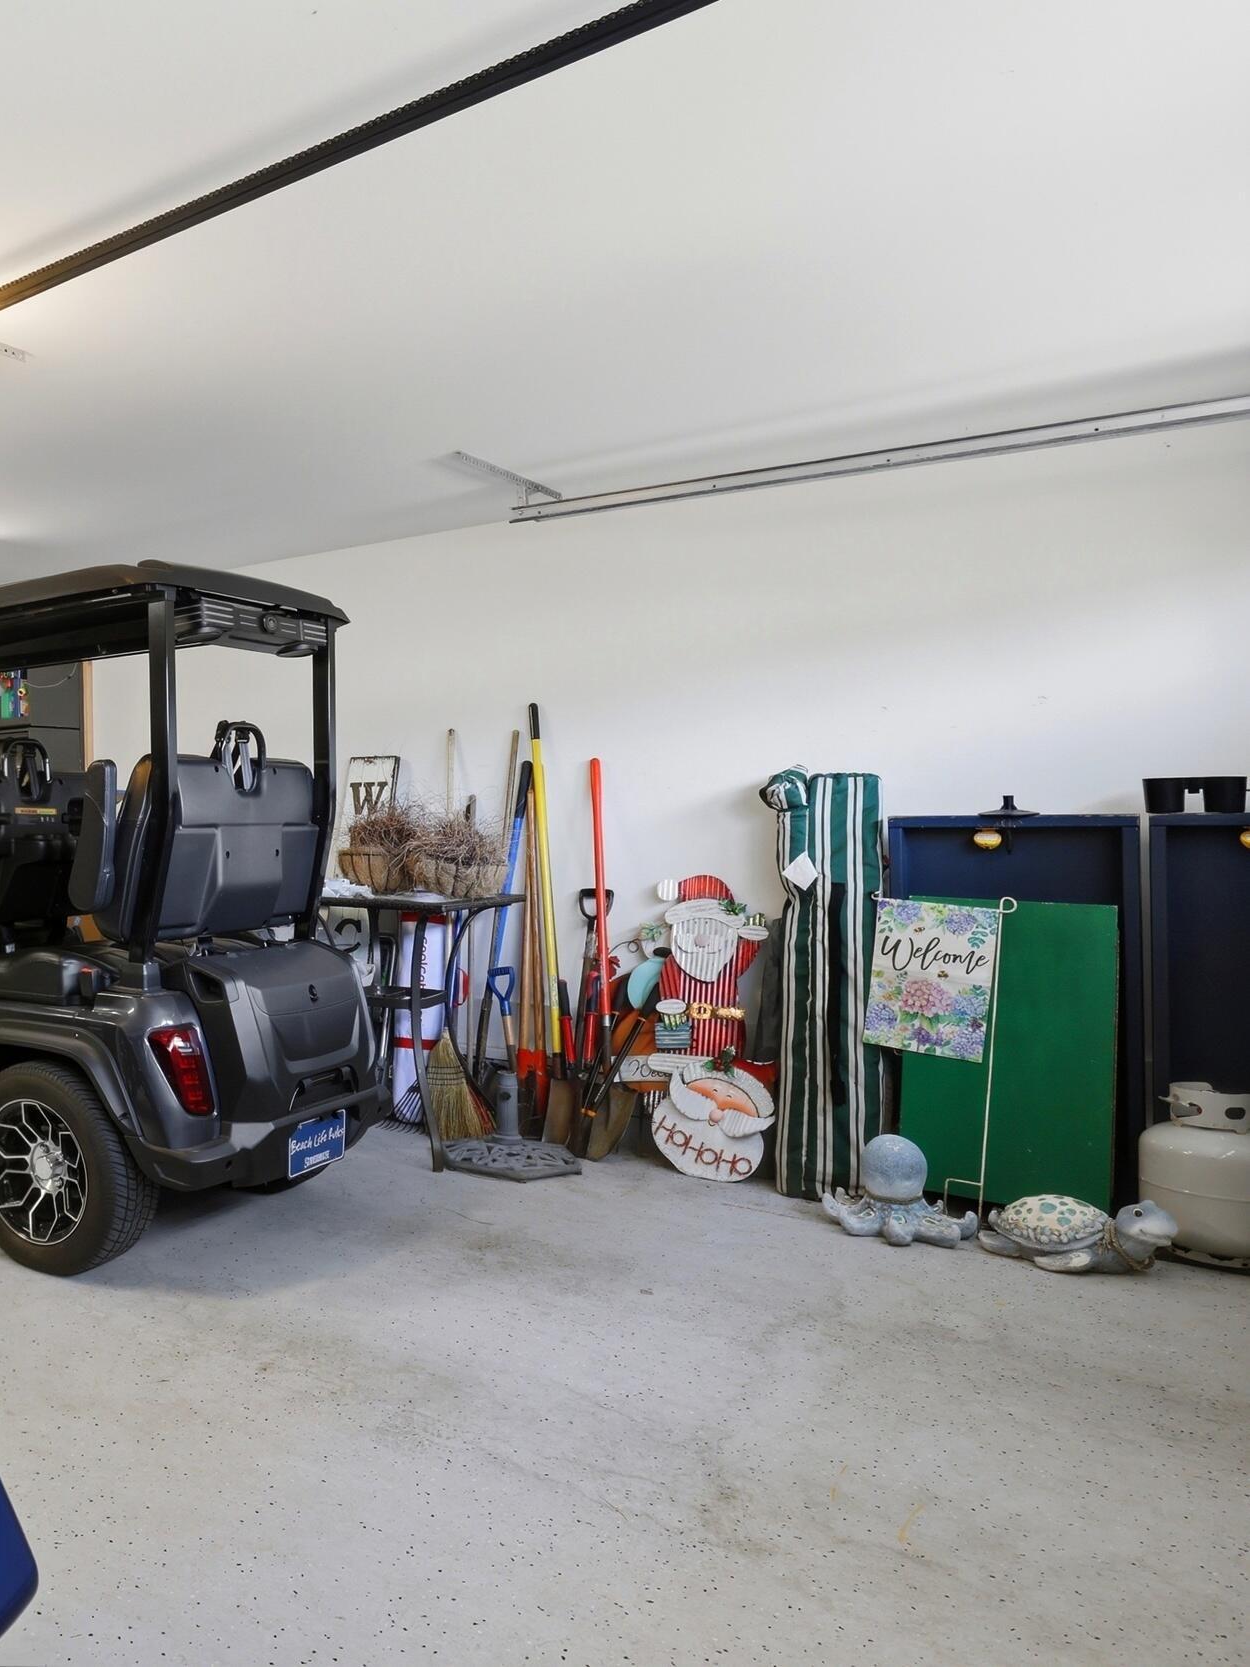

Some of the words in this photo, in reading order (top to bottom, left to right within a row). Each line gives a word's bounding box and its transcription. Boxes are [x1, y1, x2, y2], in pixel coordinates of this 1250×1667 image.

[350, 781, 388, 817] W
[880, 935, 990, 975] Welcome
[291, 1137, 312, 1155] Beach
[314, 1129, 328, 1148] Life
